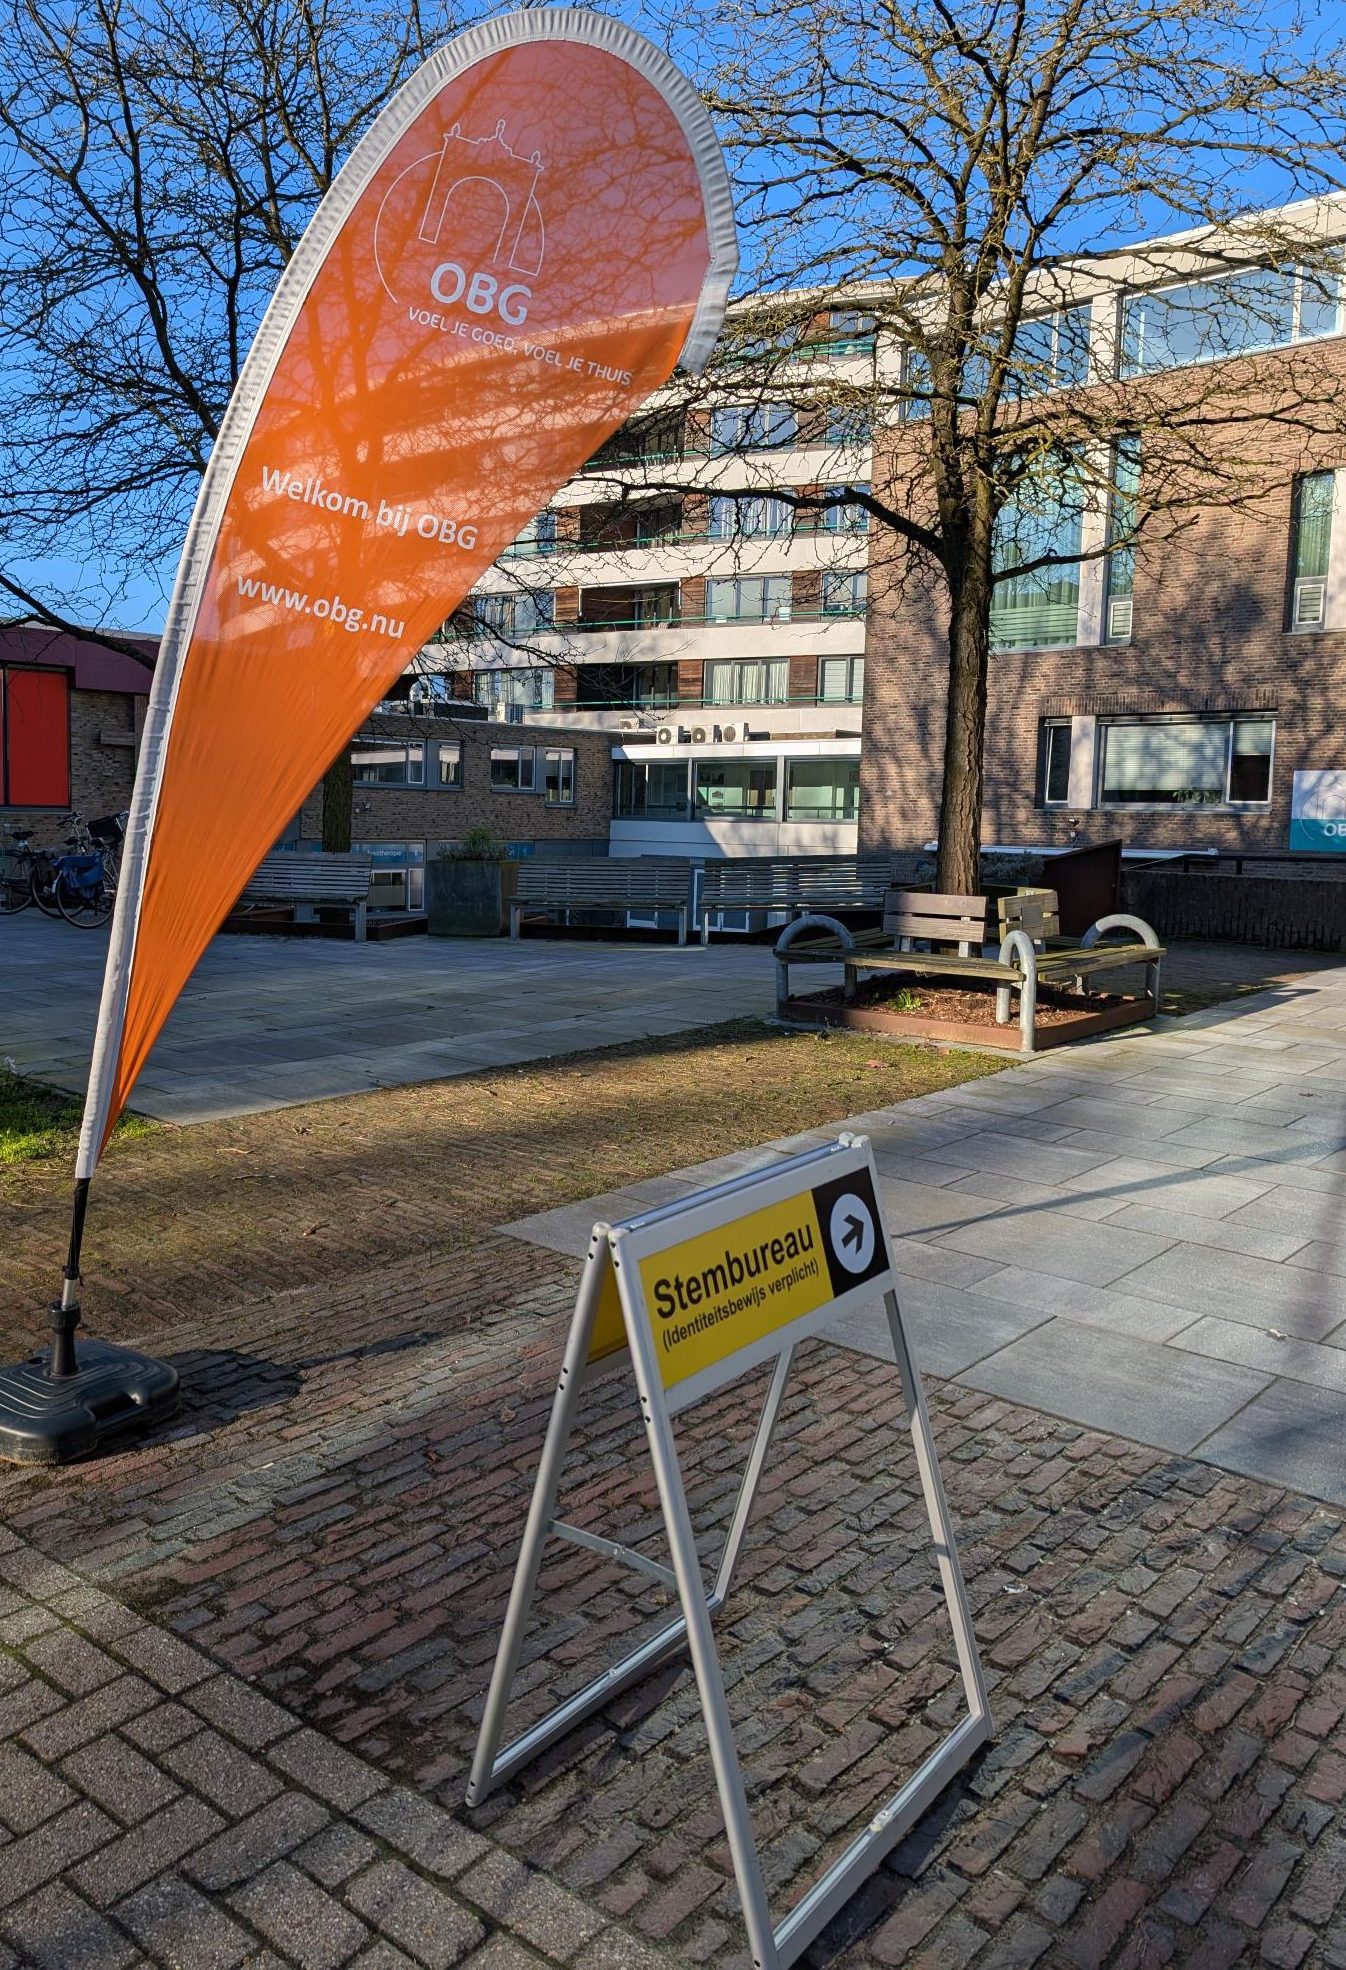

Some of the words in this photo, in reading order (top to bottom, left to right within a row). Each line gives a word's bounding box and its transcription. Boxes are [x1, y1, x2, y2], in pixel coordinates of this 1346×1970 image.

[431, 262, 532, 326] OBG
[409, 306, 448, 332] VOEL
[451, 321, 470, 338] JE
[471, 327, 518, 356] GOED,
[524, 341, 562, 367] VOEL
[565, 356, 585, 372] JE
[587, 361, 633, 386] THUIS
[262, 465, 370, 520] Welkom
[376, 500, 412, 537] bij
[417, 514, 479, 550] OBG
[237, 575, 405, 639] www.obg.nu
[653, 1224, 814, 1320] Stembureau
[662, 1285, 767, 1353] (Identiteitsbewijs
[767, 1257, 819, 1292] verplicht)
